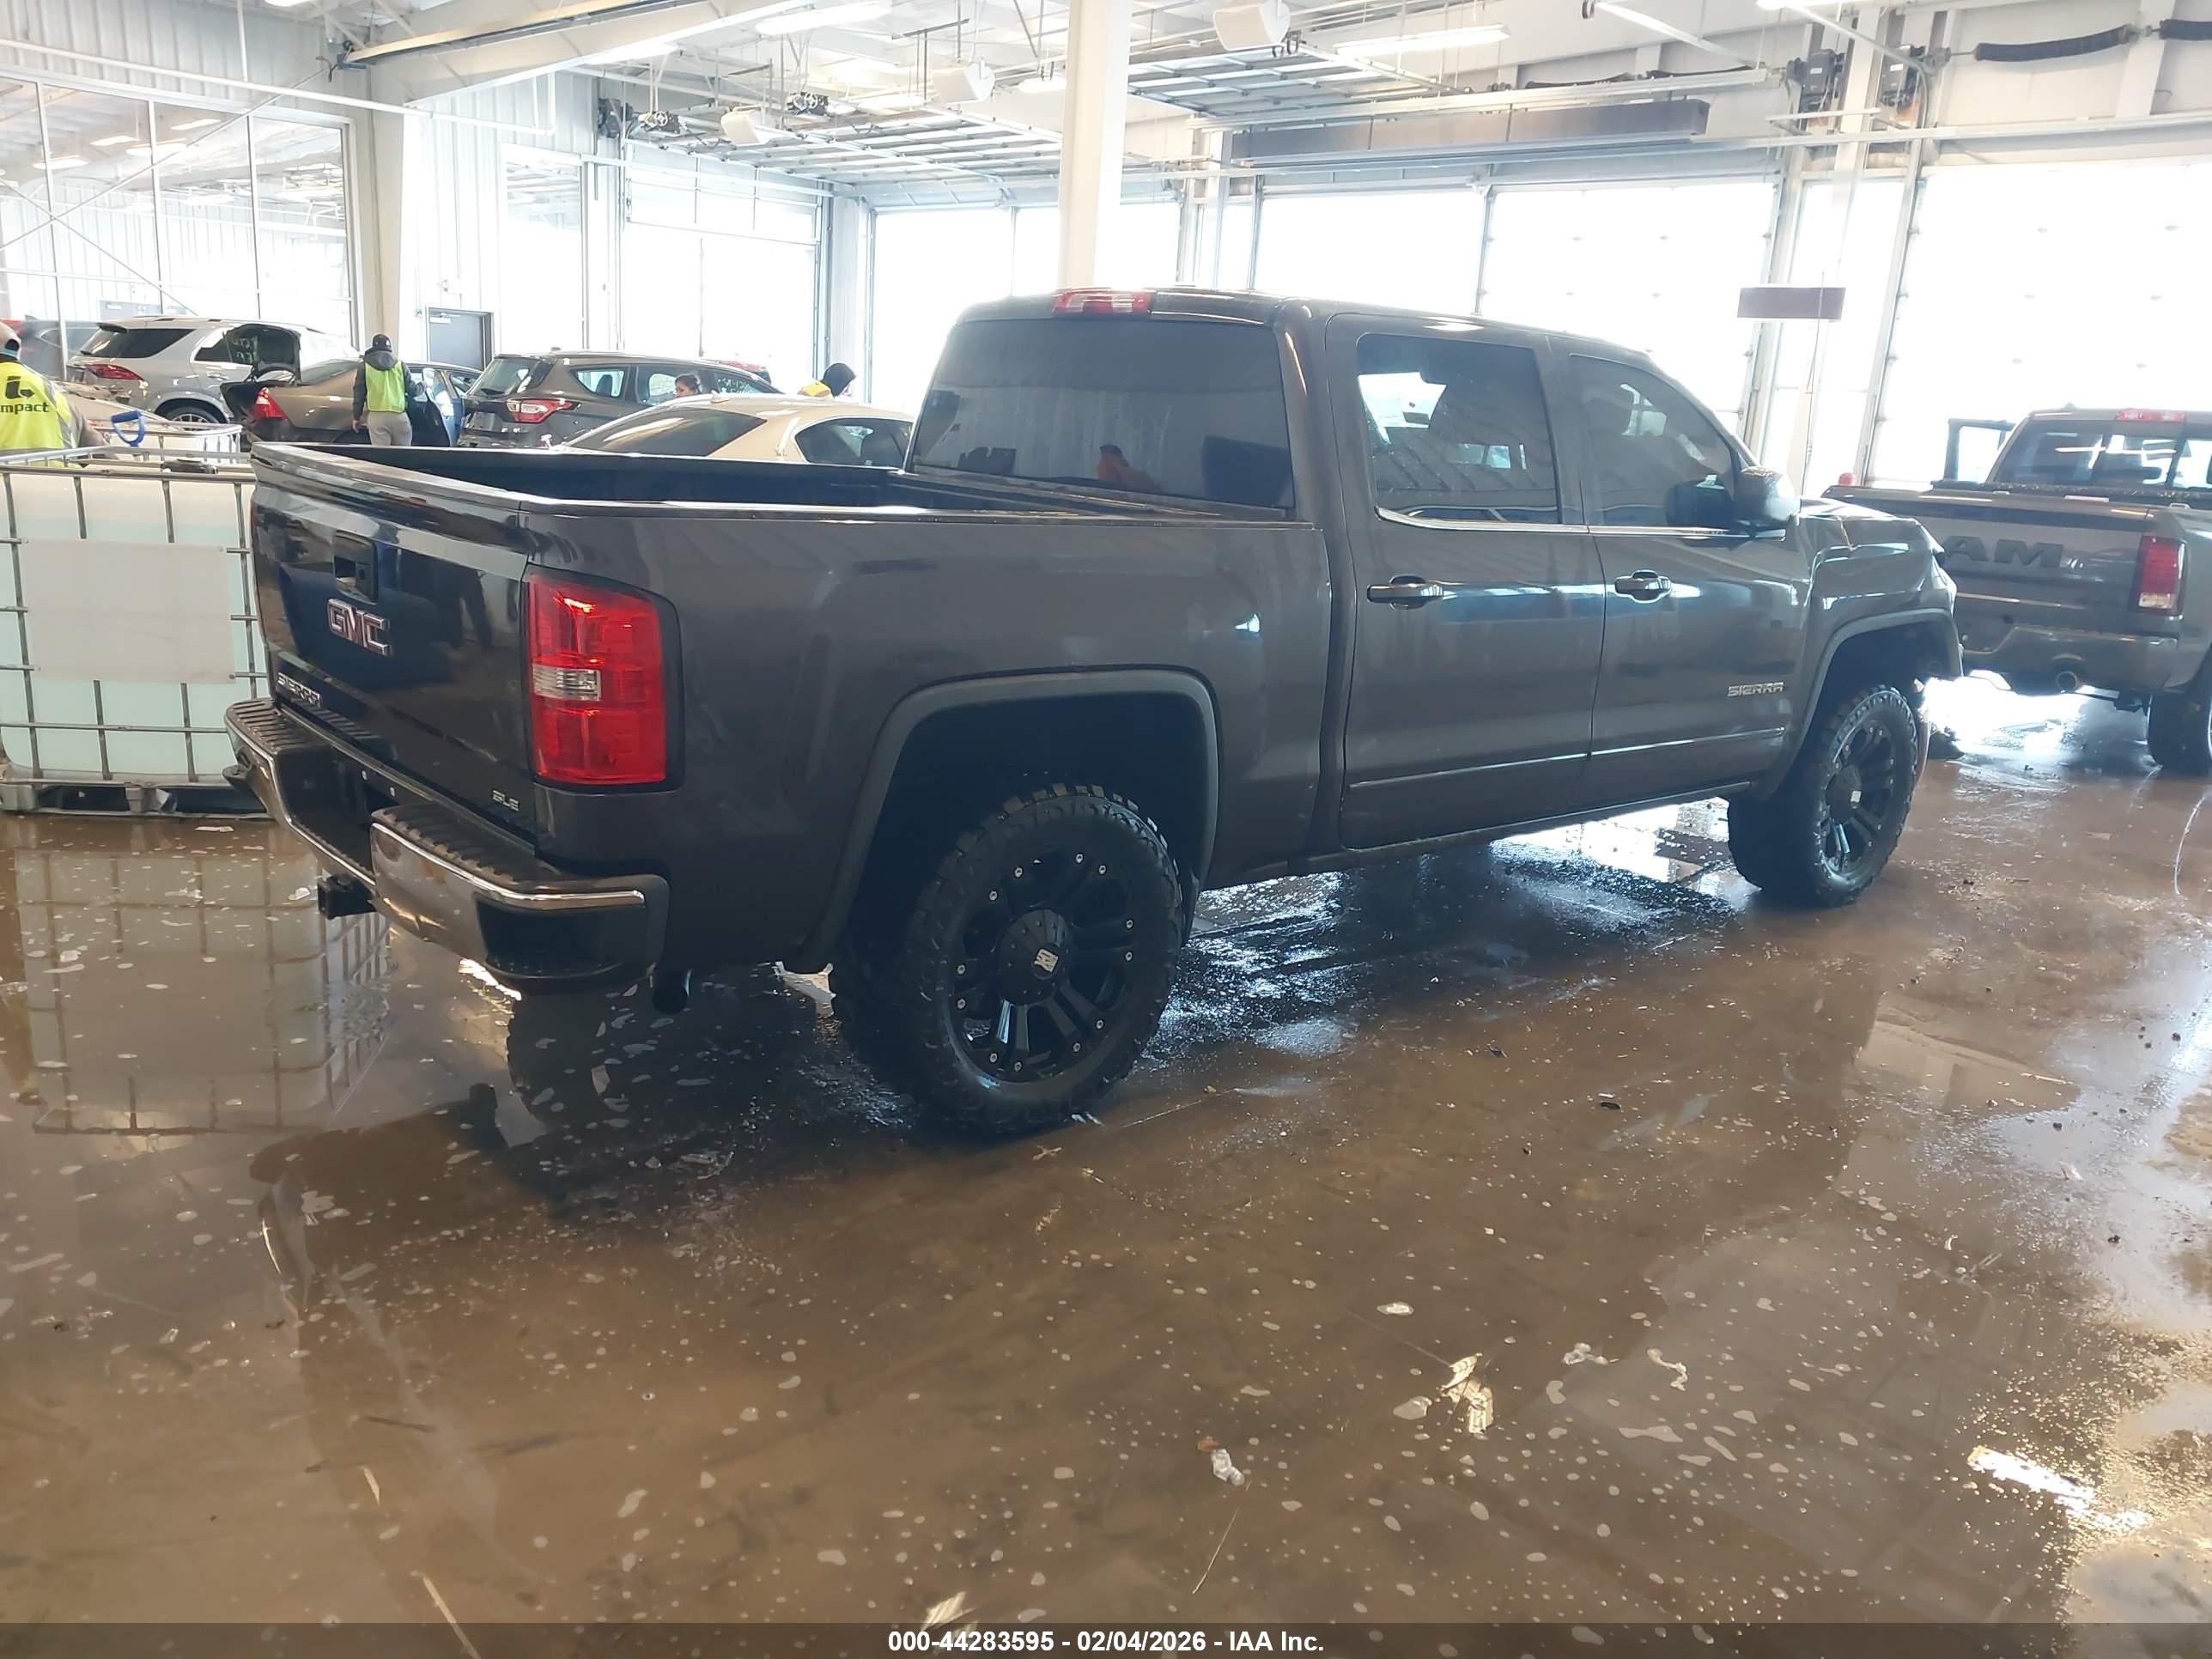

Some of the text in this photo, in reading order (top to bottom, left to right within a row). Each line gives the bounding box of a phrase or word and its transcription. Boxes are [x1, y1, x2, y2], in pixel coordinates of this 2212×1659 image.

[327, 598, 392, 657] GMC
[277, 672, 322, 708] SIERRA
[1727, 682, 1785, 697] SIERRA
